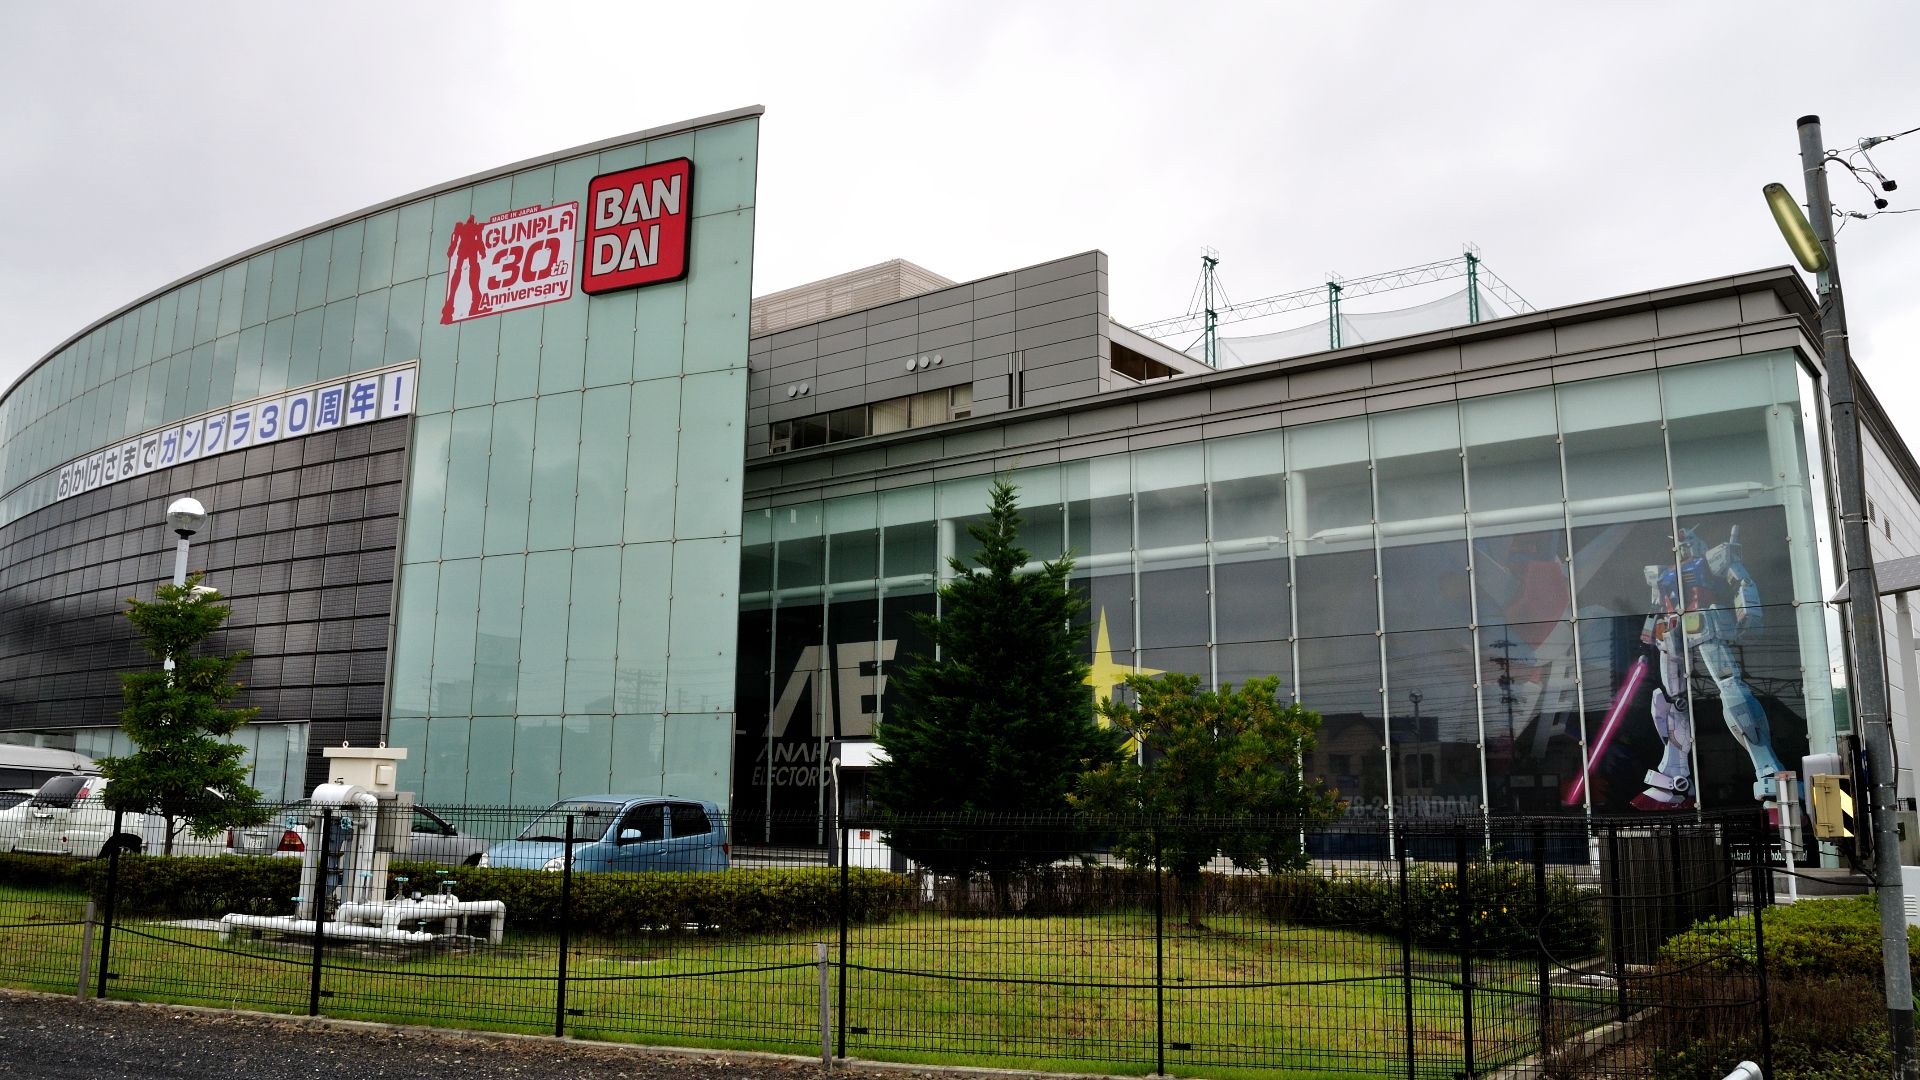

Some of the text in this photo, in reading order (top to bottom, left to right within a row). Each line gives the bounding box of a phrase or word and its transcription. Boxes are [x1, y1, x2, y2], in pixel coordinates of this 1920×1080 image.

[491, 213, 509, 223] MADE
[518, 206, 538, 216] JAPAN
[595, 174, 682, 230] BAN
[485, 210, 574, 250] GUNPLA
[591, 224, 661, 276] DAI
[479, 279, 569, 310] Anniversary
[754, 742, 831, 763] ANAH
[752, 766, 831, 787] ELECTORO
